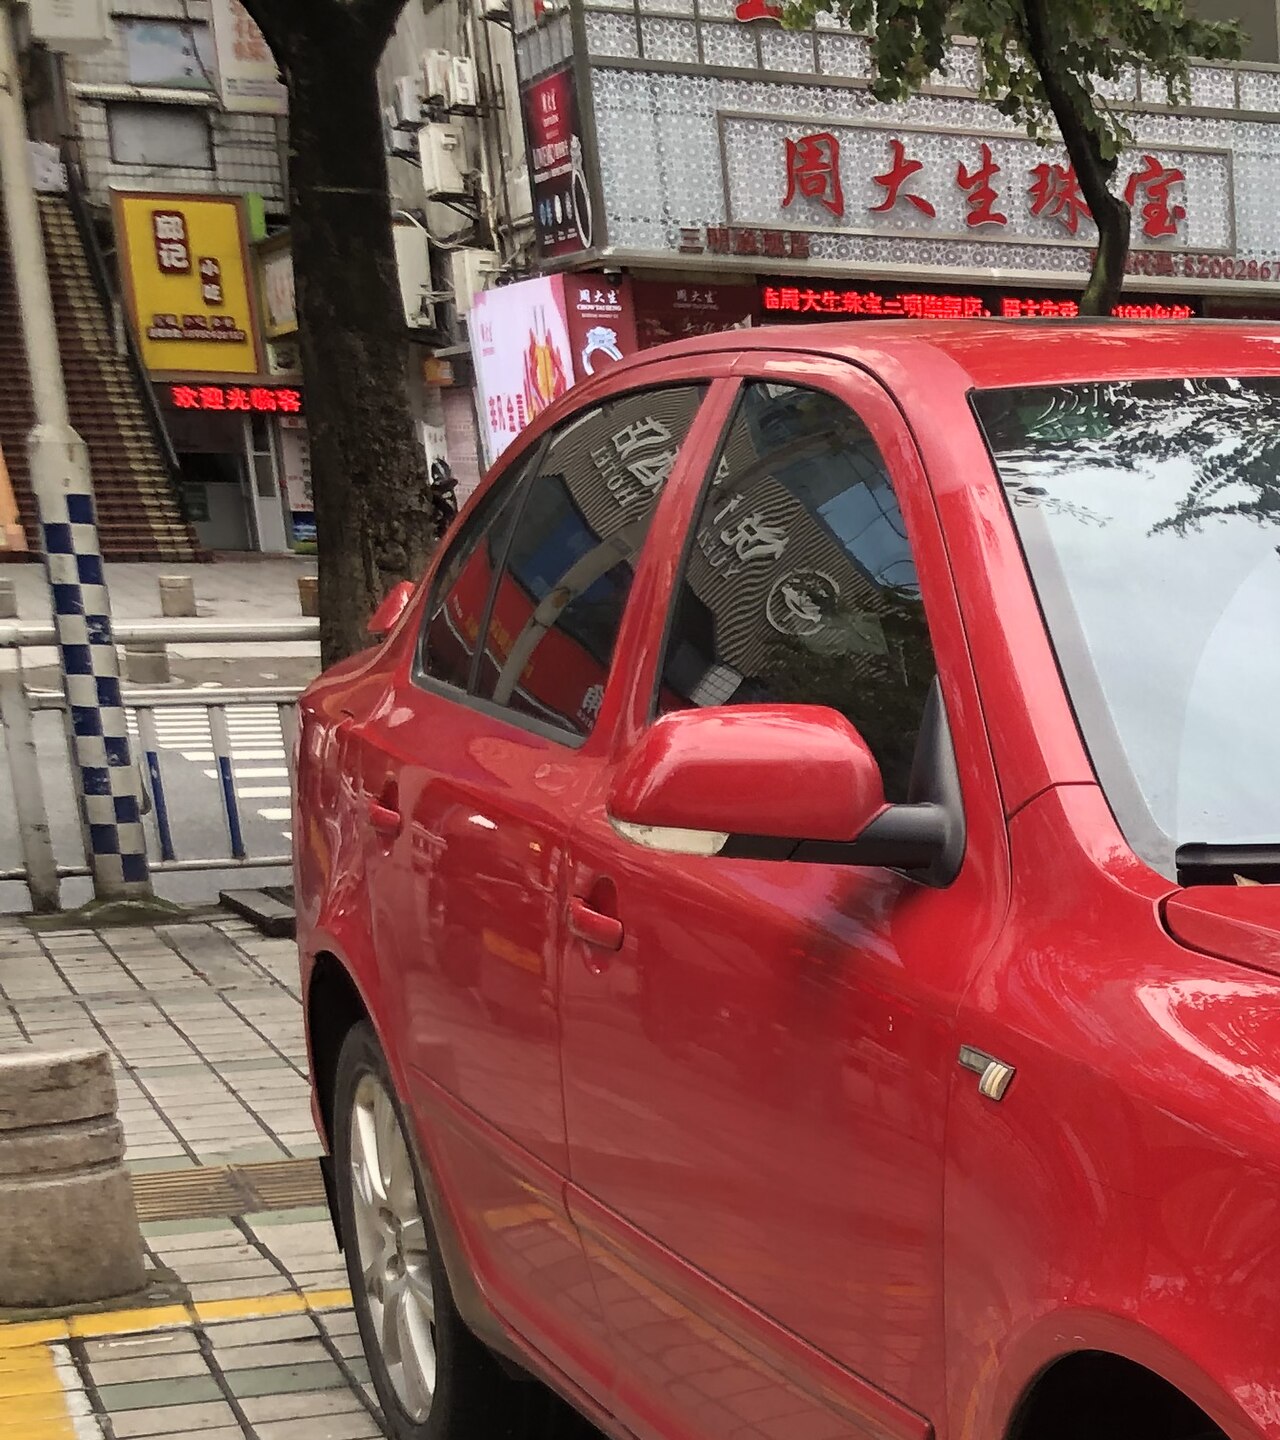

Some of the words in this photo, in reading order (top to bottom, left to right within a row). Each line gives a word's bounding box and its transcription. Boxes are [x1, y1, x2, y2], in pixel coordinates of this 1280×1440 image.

[781, 131, 1187, 240] 周大生珠宝
[579, 288, 619, 304] 周大生
